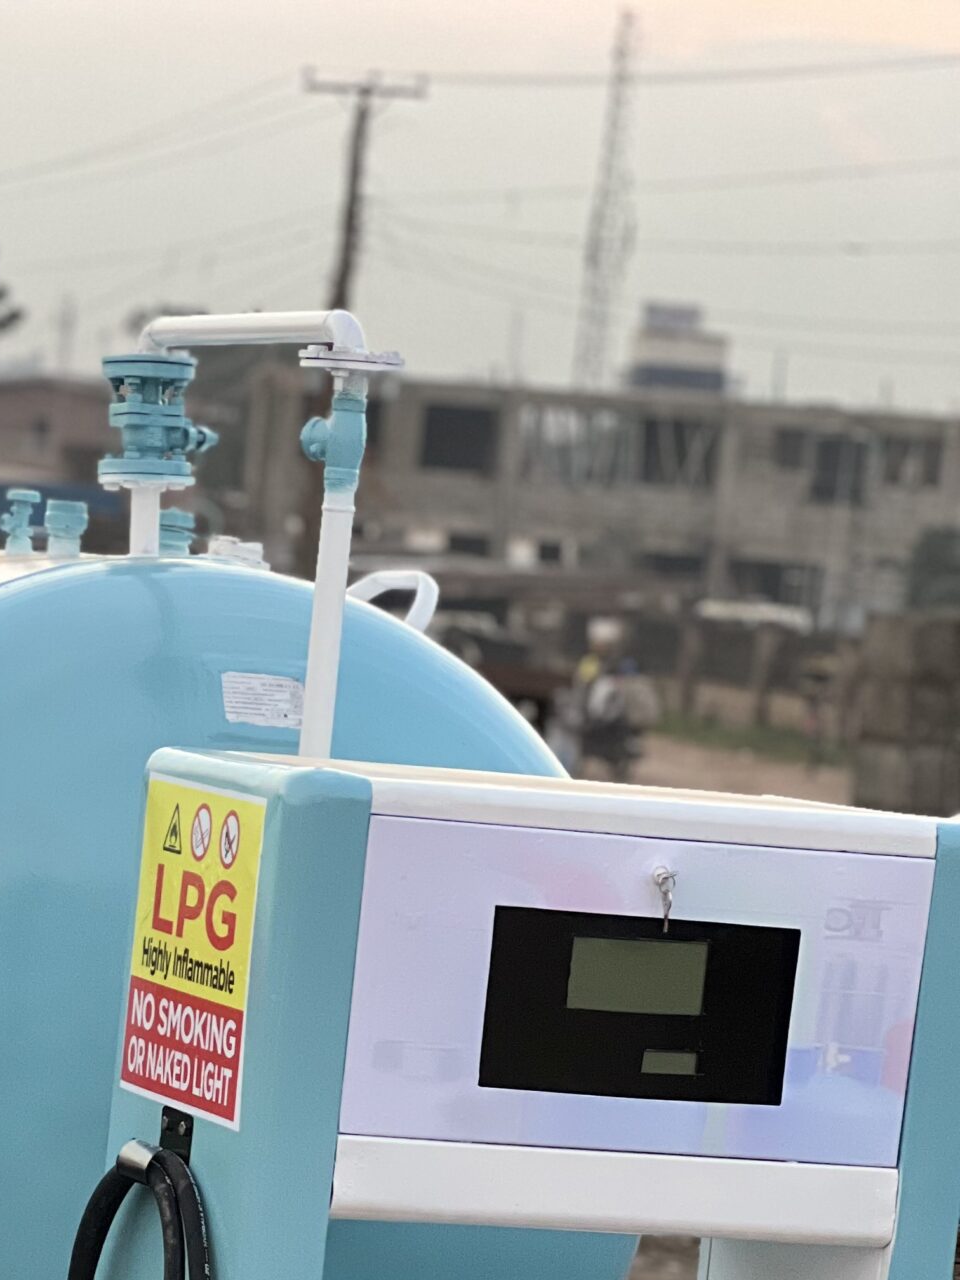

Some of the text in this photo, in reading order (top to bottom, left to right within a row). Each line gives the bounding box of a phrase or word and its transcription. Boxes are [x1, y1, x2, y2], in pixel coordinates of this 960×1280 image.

[151, 862, 237, 951] LPG
[141, 935, 235, 995] Highly Inflammable
[131, 987, 237, 1059] NO SMOKING
[127, 1034, 233, 1106] OR NAKED LIGHT
